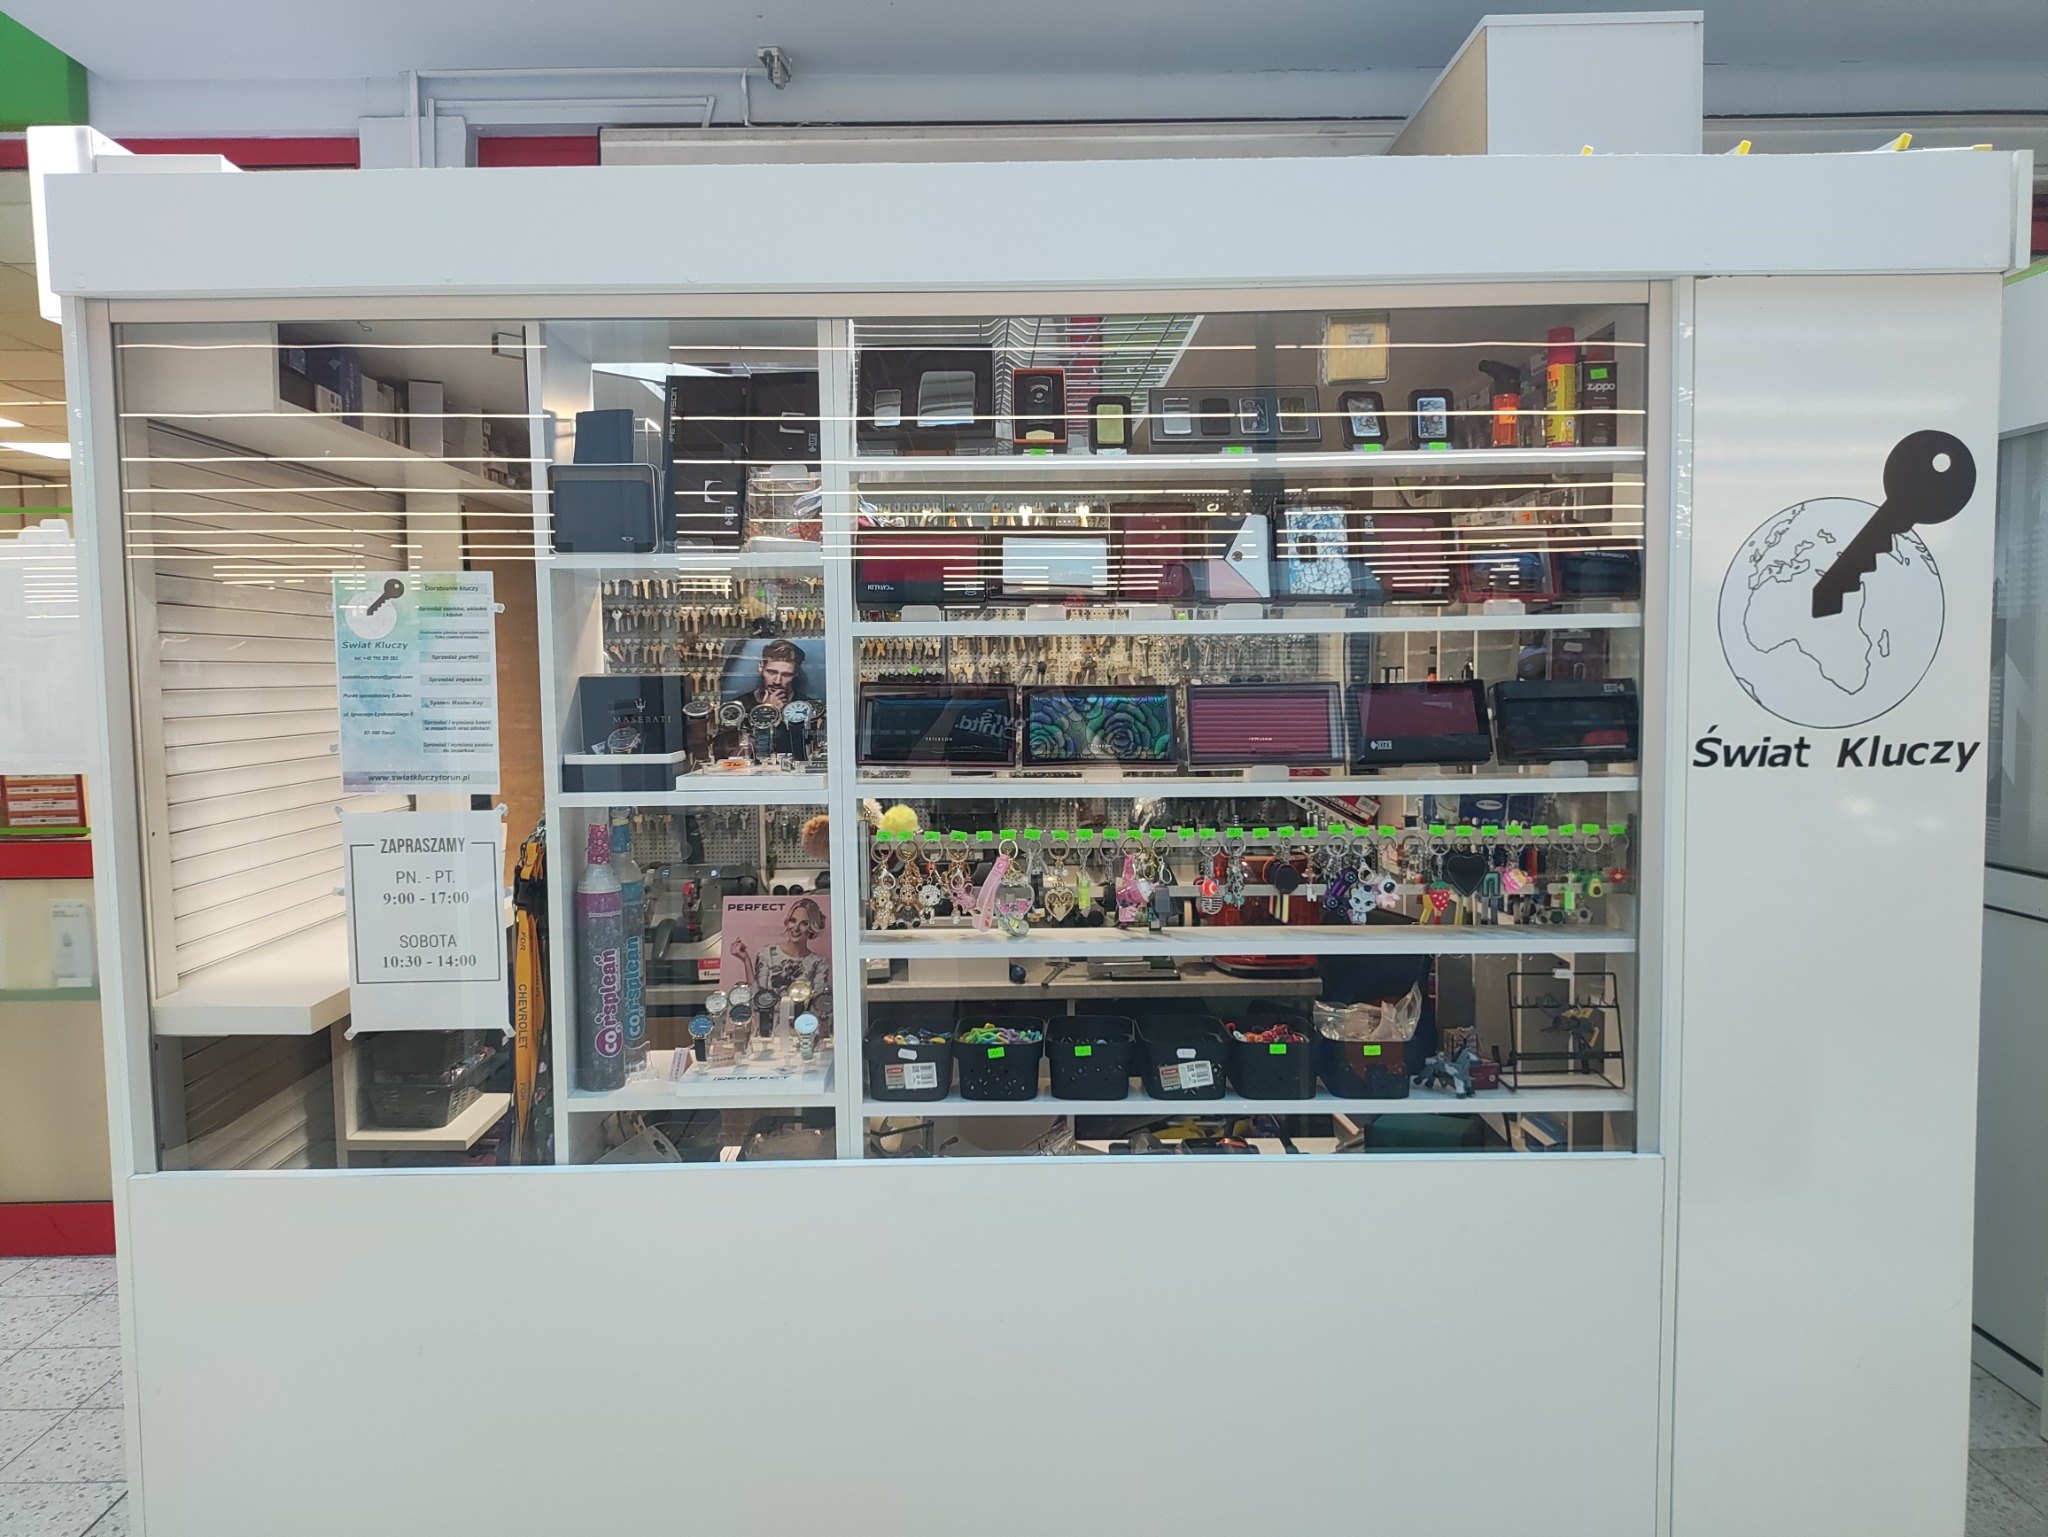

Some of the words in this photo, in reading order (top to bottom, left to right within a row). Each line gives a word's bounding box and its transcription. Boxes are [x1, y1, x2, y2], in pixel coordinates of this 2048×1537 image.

[341, 639, 372, 649] Świat
[374, 640, 409, 651] Kluczy
[613, 715, 672, 724] MASERATI
[1692, 725, 1811, 767] Świat
[1836, 735, 1981, 773] Kluczy
[367, 773, 471, 783] www.swiatkluczytorun.pl
[380, 837, 466, 854] ZAPRASZAMY
[395, 870, 421, 884] PN.
[434, 869, 456, 884] PT.
[383, 892, 415, 905] 9:00
[430, 890, 470, 904] 17:00
[727, 903, 786, 912] PERFECT
[399, 934, 458, 948] SOBOTA
[519, 930, 527, 952] FOR
[382, 955, 422, 968] 10:30
[437, 954, 477, 967] 14:00
[518, 983, 528, 1051] CHEVROLET
